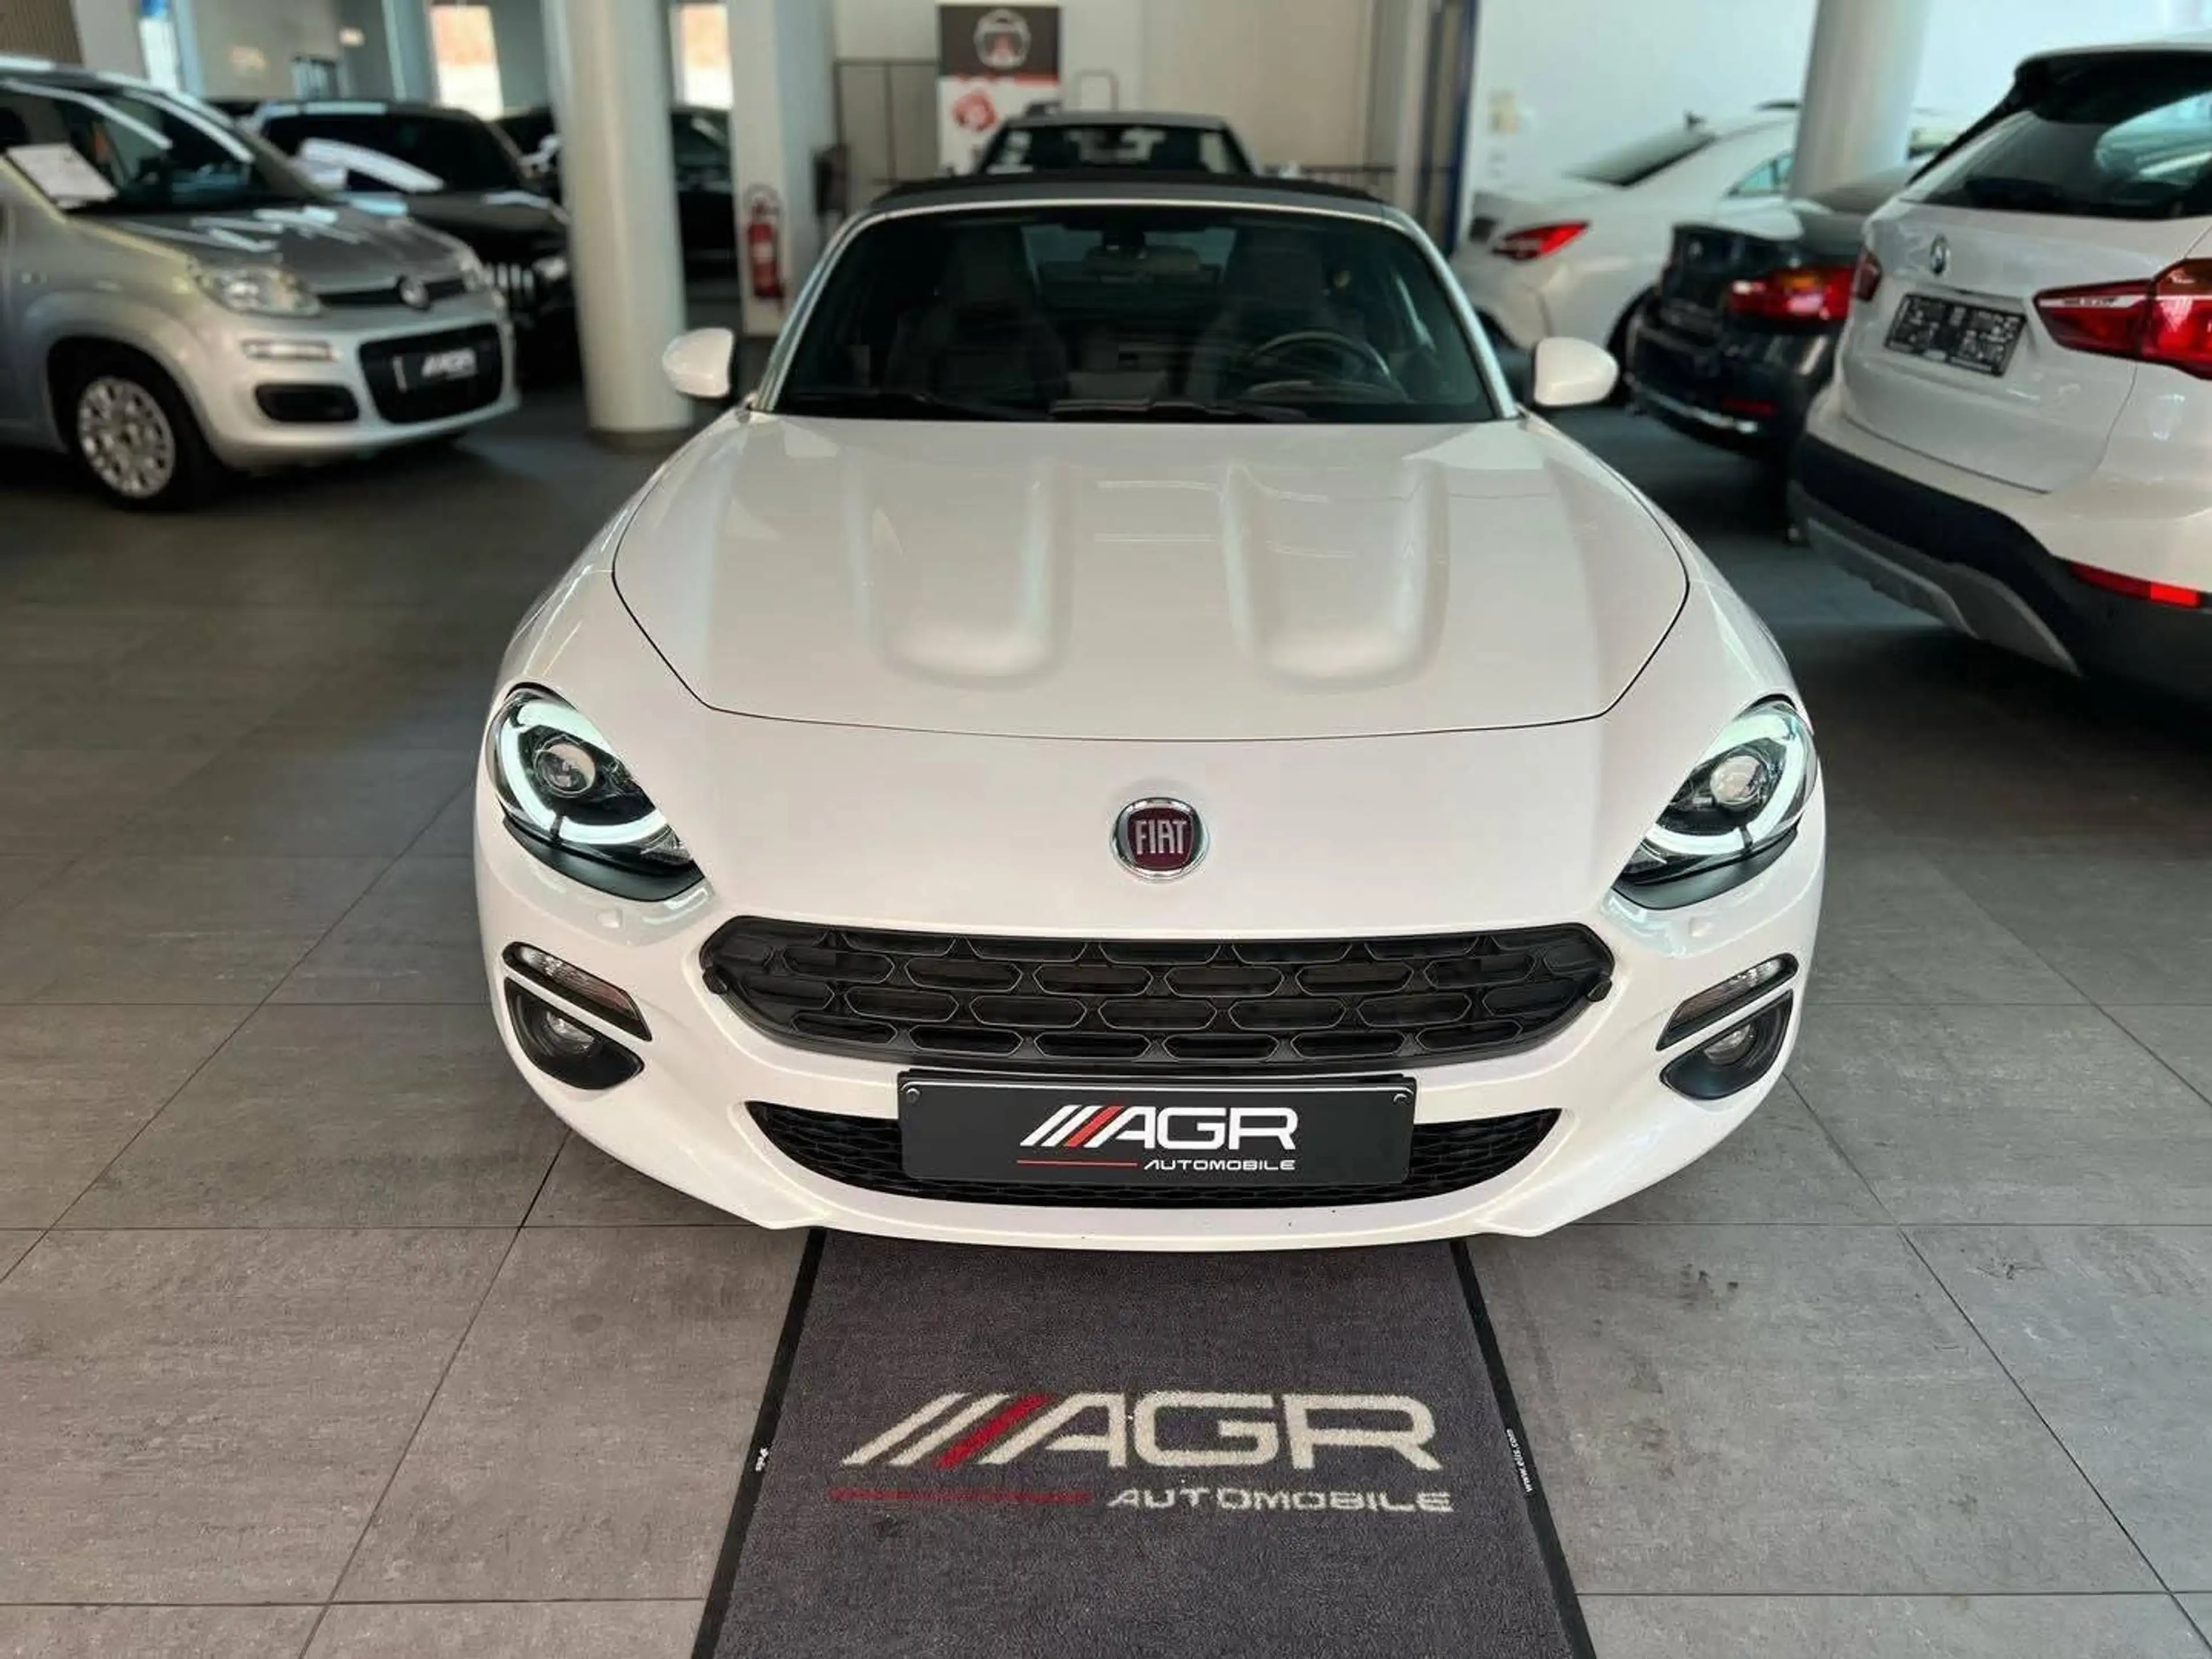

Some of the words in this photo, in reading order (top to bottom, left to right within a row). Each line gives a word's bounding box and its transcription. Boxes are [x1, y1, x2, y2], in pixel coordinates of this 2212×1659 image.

[1135, 819, 1187, 855] FIAT
[1084, 1106, 1299, 1150] AGR
[1143, 1159, 1296, 1171] AUTOMOBILE
[978, 1391, 1442, 1469] AGR
[1105, 1487, 1454, 1513] AUTOMOBILE
